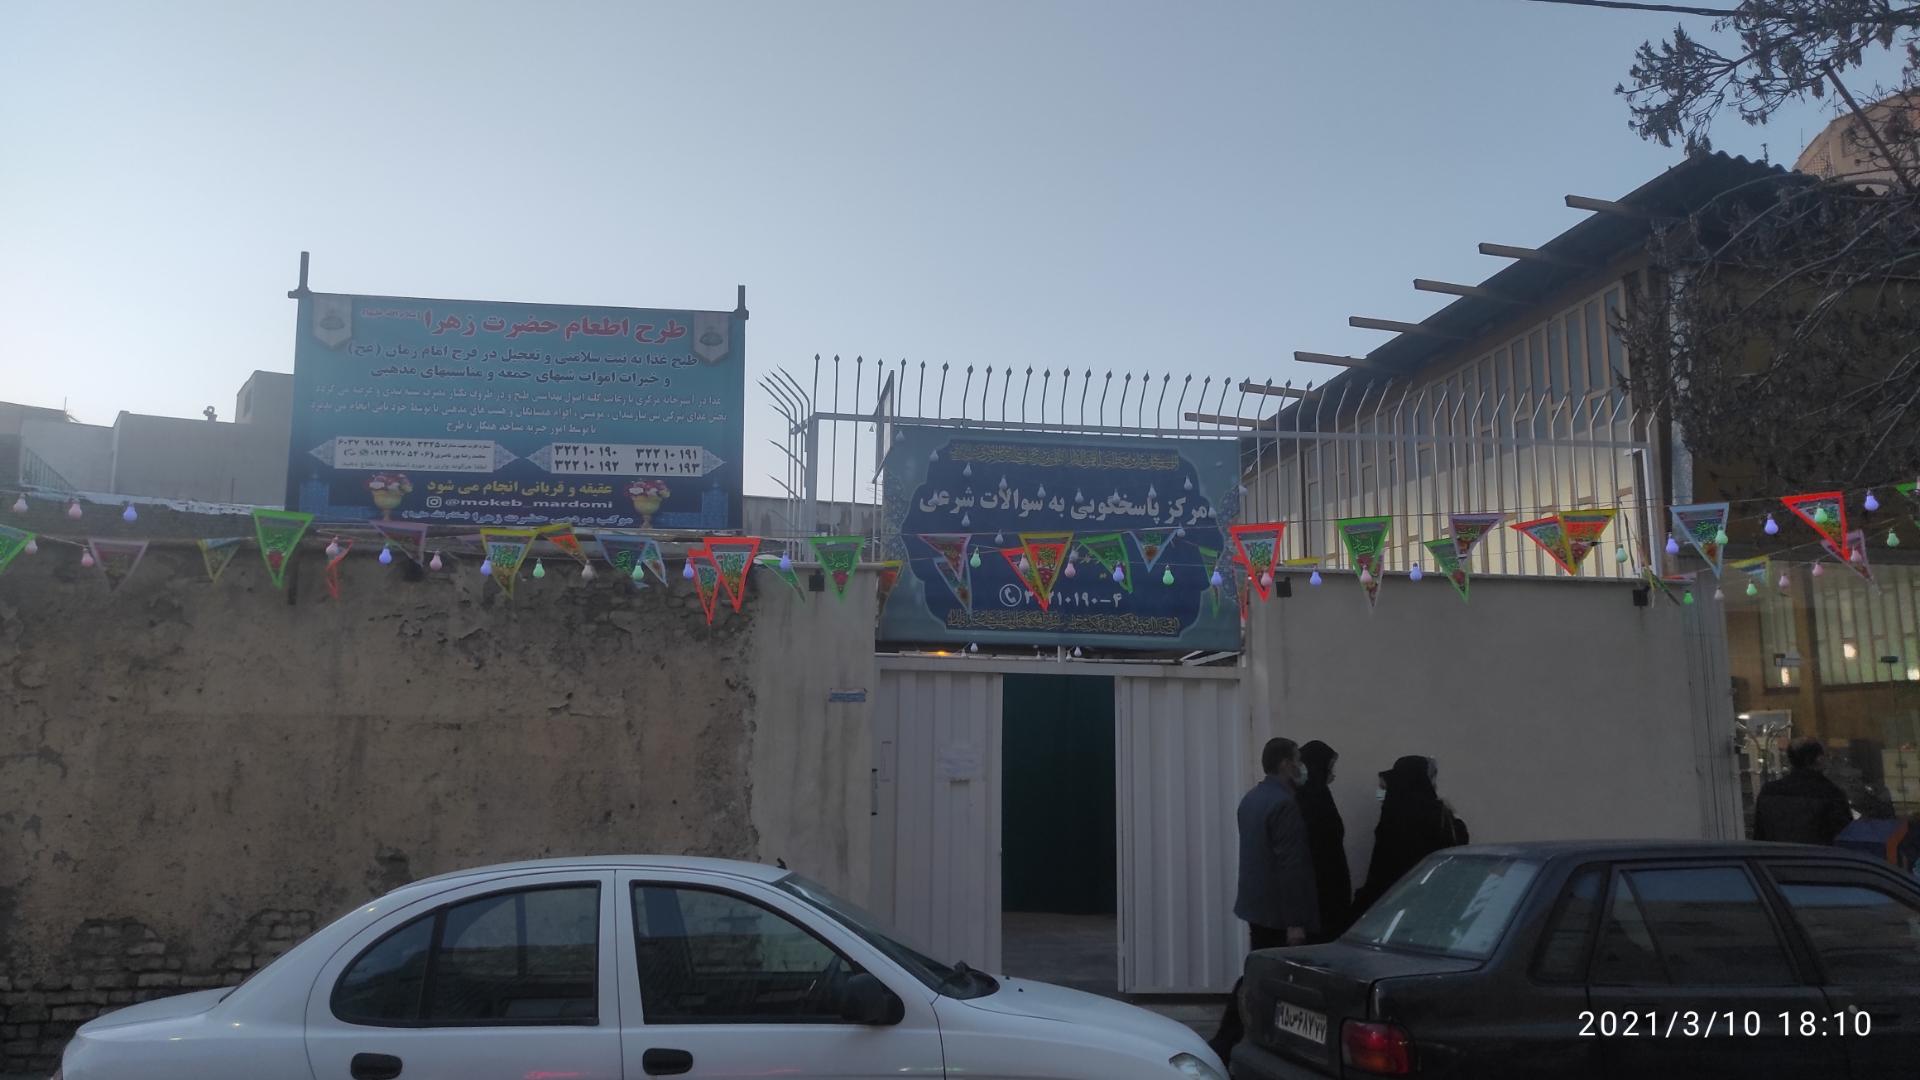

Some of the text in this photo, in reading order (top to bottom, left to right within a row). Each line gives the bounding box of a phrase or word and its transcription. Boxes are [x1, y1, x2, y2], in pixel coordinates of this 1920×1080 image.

[423, 309, 476, 336] زهرا
[482, 315, 558, 338] حضرت
[565, 315, 629, 342] اطعام
[634, 319, 687, 344] طرح
[349, 343, 381, 357] (عج)
[385, 344, 418, 358] زمان
[421, 345, 448, 360] امام
[451, 347, 477, 361] فرج
[481, 350, 497, 362] در
[501, 349, 540, 362] تعجیل
[555, 351, 600, 365] سلامتی
[604, 355, 627, 365] نیت
[631, 355, 642, 366] به
[646, 353, 667, 365] غذا
[671, 353, 698, 368] طبخ
[371, 364, 417, 377] مذهبی
[498, 370, 532, 380] جمعه
[535, 369, 575, 384] شبهای
[579, 371, 616, 385] اموات
[619, 373, 659, 387] خیرات
[554, 445, 579, 456] ۳۲۲
[636, 447, 660, 459] ۳۲۲
[554, 460, 579, 471] ۳۲۲
[635, 462, 659, 473] ۳۲۲
[427, 479, 613, 498] عقیقه و قربانی انجام می شود
[445, 498, 613, 509] @mokeb_mardomi
[919, 486, 1208, 525] مرکز پاسخگویی به سوالات شرعی
[472, 511, 503, 525] زهرا
[503, 512, 549, 525] حضرت
[596, 514, 634, 526] موکب
